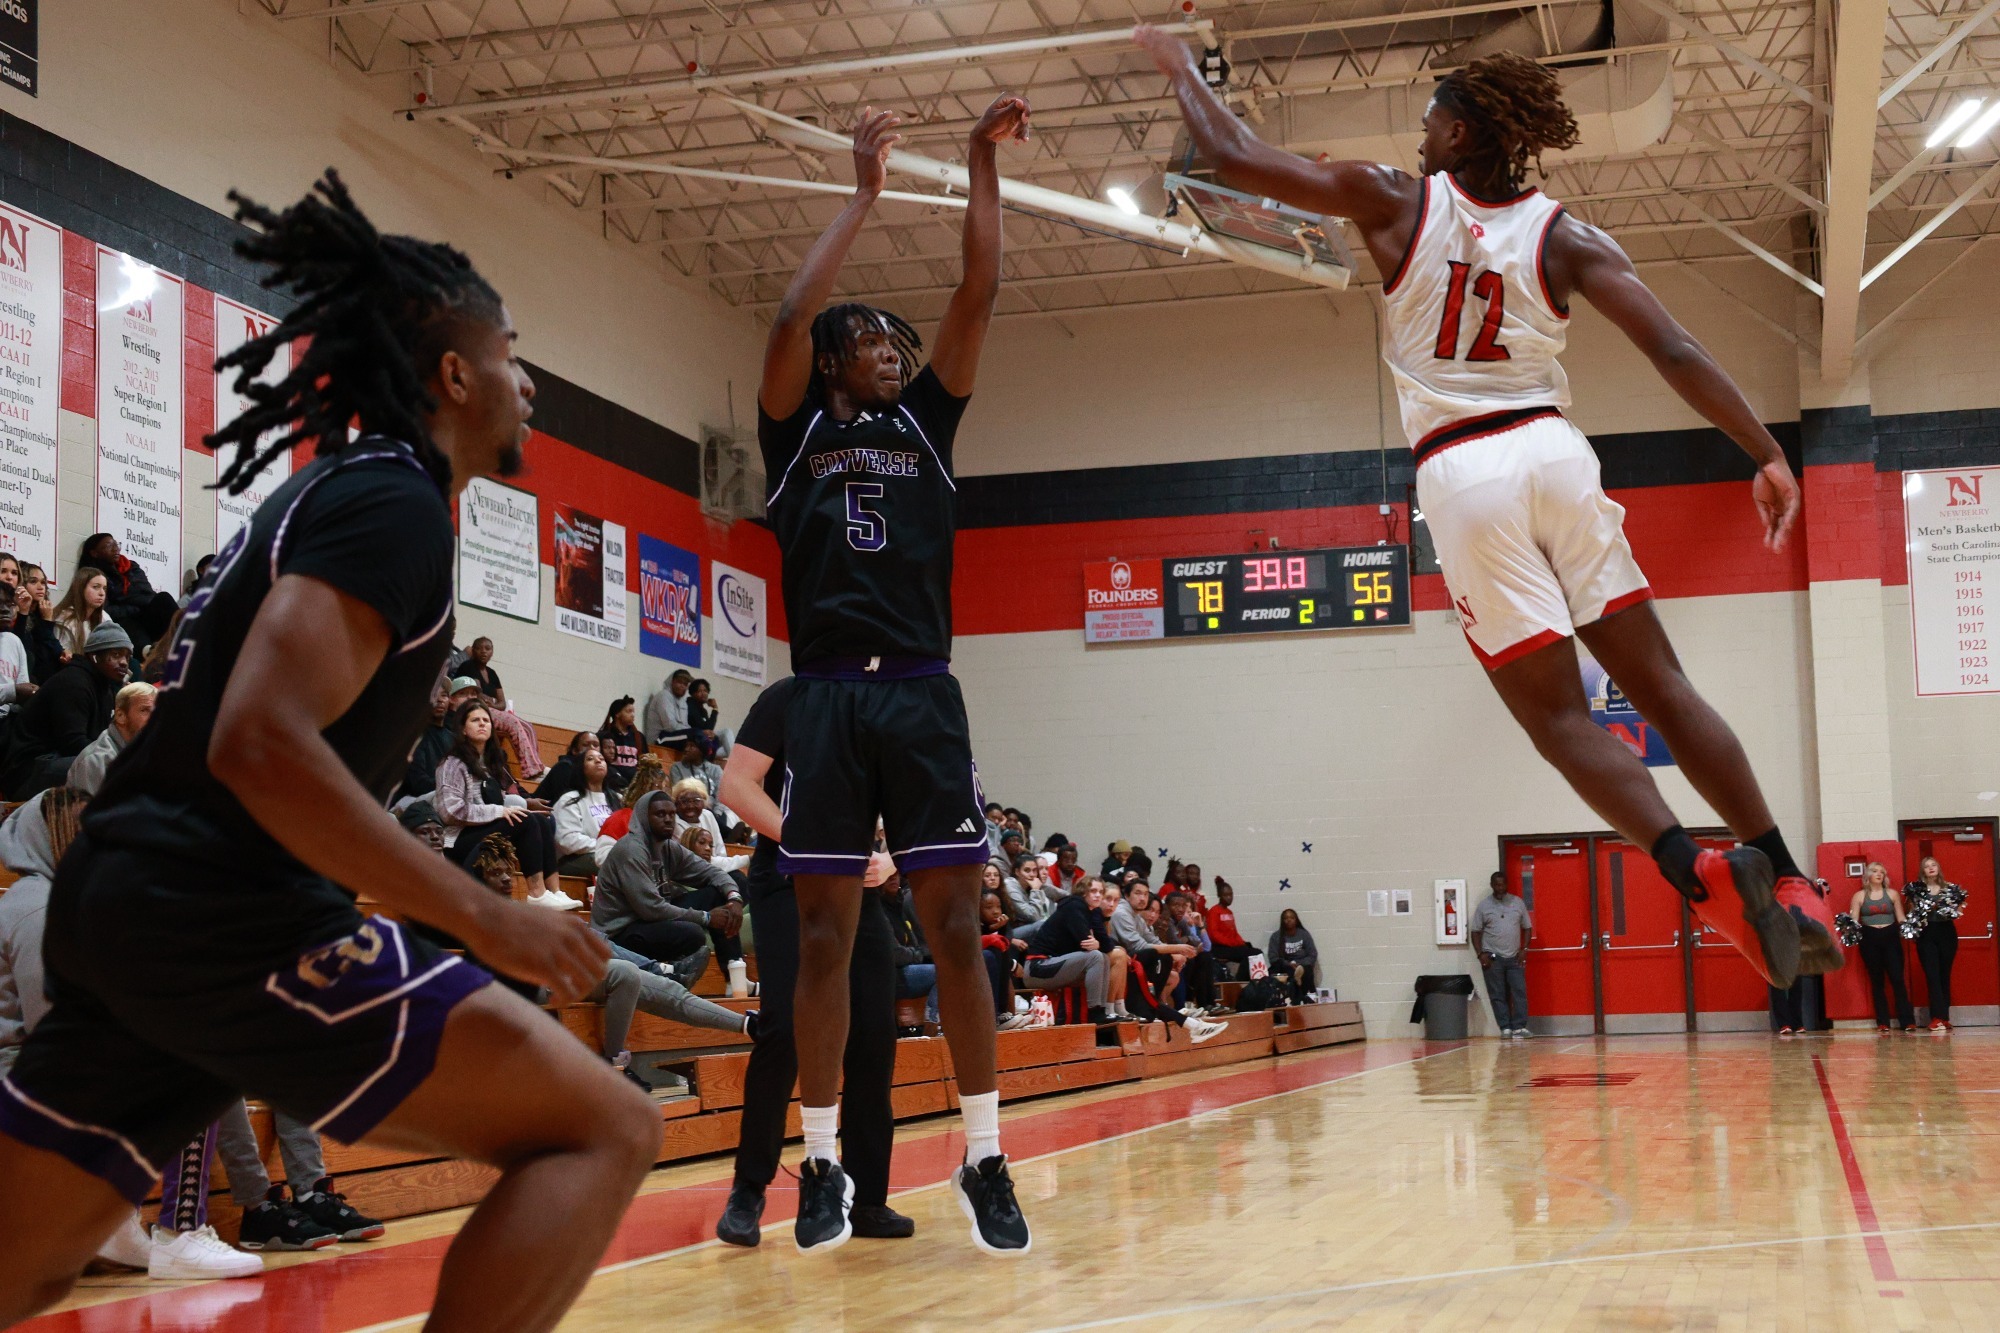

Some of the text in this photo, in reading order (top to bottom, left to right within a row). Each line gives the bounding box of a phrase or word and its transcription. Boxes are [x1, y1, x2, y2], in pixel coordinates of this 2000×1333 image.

[2, 66, 31, 87] CHAMPS
[1433, 259, 1512, 362] 12
[123, 317, 159, 338] NEWBERRY
[22, 352, 30, 367] II
[122, 334, 161, 364] Wrestling
[5, 365, 35, 387] Region
[123, 359, 138, 375] 2012
[144, 367, 159, 382] 2013
[126, 375, 156, 396] NCAA II
[114, 385, 135, 403] Super
[137, 392, 162, 411] Region
[22, 407, 30, 422] II
[120, 406, 162, 430] Champions
[6, 438, 29, 456] Place
[125, 432, 156, 453] NCAA II
[99, 445, 181, 482] National Championships
[809, 448, 919, 479] CONVERSE
[32, 468, 56, 487] Duals
[124, 469, 157, 490] 6th Place
[99, 485, 180, 518] NCWA National Duals
[218, 498, 245, 516] National
[473, 485, 507, 514] NEWBERRY
[123, 507, 157, 527] 5th Place
[845, 482, 887, 552] 5
[1939, 508, 1990, 518] NEWBERRY
[0, 516, 42, 541] Nationally
[126, 528, 154, 546] Ranked
[1917, 525, 1952, 537] Men's
[130, 545, 169, 567] Nationally
[606, 539, 623, 558] WILSON
[1931, 542, 1959, 552] South
[1172, 561, 1227, 577] GUEST
[1343, 551, 1393, 567] HOME
[1926, 555, 1951, 564] State
[604, 566, 624, 586] TRACTOR
[1243, 557, 1307, 592] 39.8
[1954, 570, 1982, 583] 1914
[641, 572, 689, 625] WKDK
[726, 582, 754, 611] InSite
[1088, 588, 1159, 604] FOUNDERS
[1185, 581, 1224, 613] 78
[1353, 571, 1392, 605] 56
[1956, 588, 1983, 600] 1915
[1242, 600, 1315, 624] PERIOD 2
[1956, 605, 1984, 617] 1916
[561, 612, 570, 630] 440
[571, 615, 589, 635] WILSON
[597, 623, 622, 644] NEWBERRY
[671, 610, 699, 644] Voice
[1957, 622, 1985, 634] 1917
[1958, 639, 1987, 651] 1922
[1959, 656, 1988, 668] 1923
[1960, 673, 1989, 686] 1924
